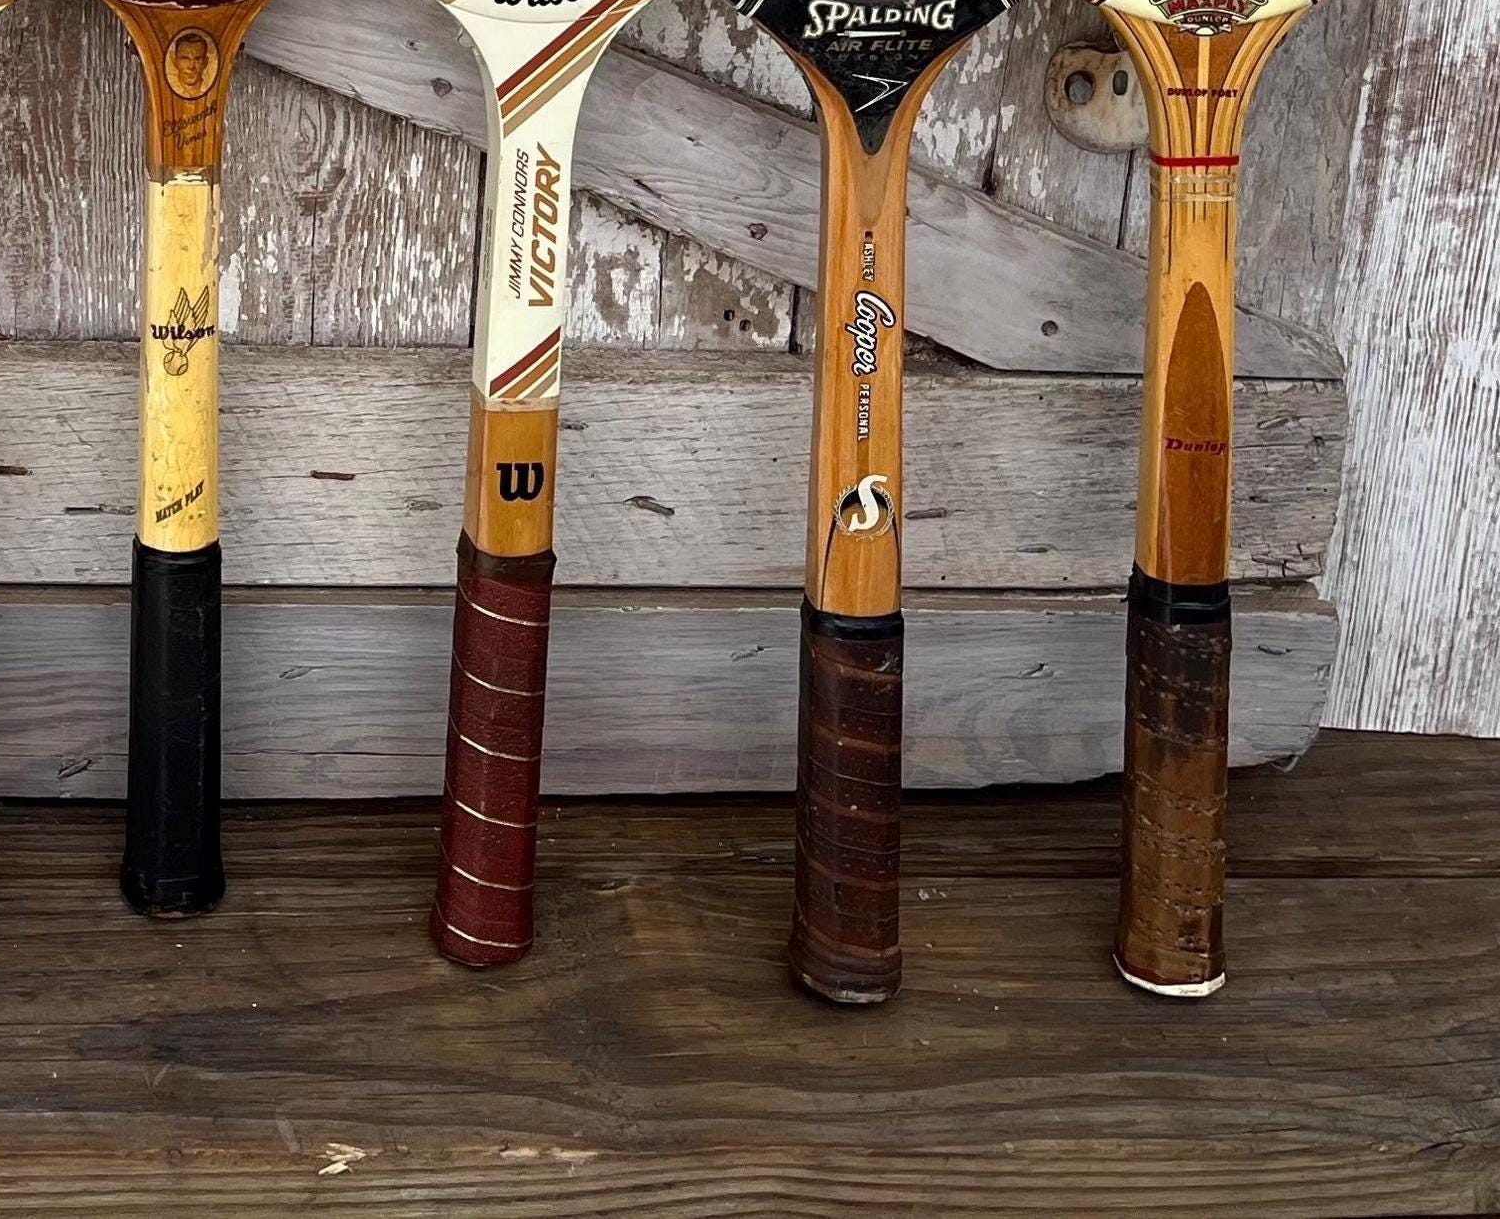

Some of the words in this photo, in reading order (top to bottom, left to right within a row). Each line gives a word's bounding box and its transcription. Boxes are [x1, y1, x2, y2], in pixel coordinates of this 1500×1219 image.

[825, 39, 864, 52] AIR
[869, 39, 933, 52] FLITE
[1167, 87, 1208, 97] DUNLOP
[511, 147, 530, 239] CONNORS
[528, 141, 561, 307] VICTORY
[508, 235, 525, 300] JIMMY
[150, 324, 216, 340] Wilson
[846, 290, 896, 377] Cooper
[858, 383, 870, 442] PERSONAL
[1165, 437, 1227, 456] Dunlop
[155, 498, 183, 523] MATCH
[184, 479, 205, 507] PLAY
